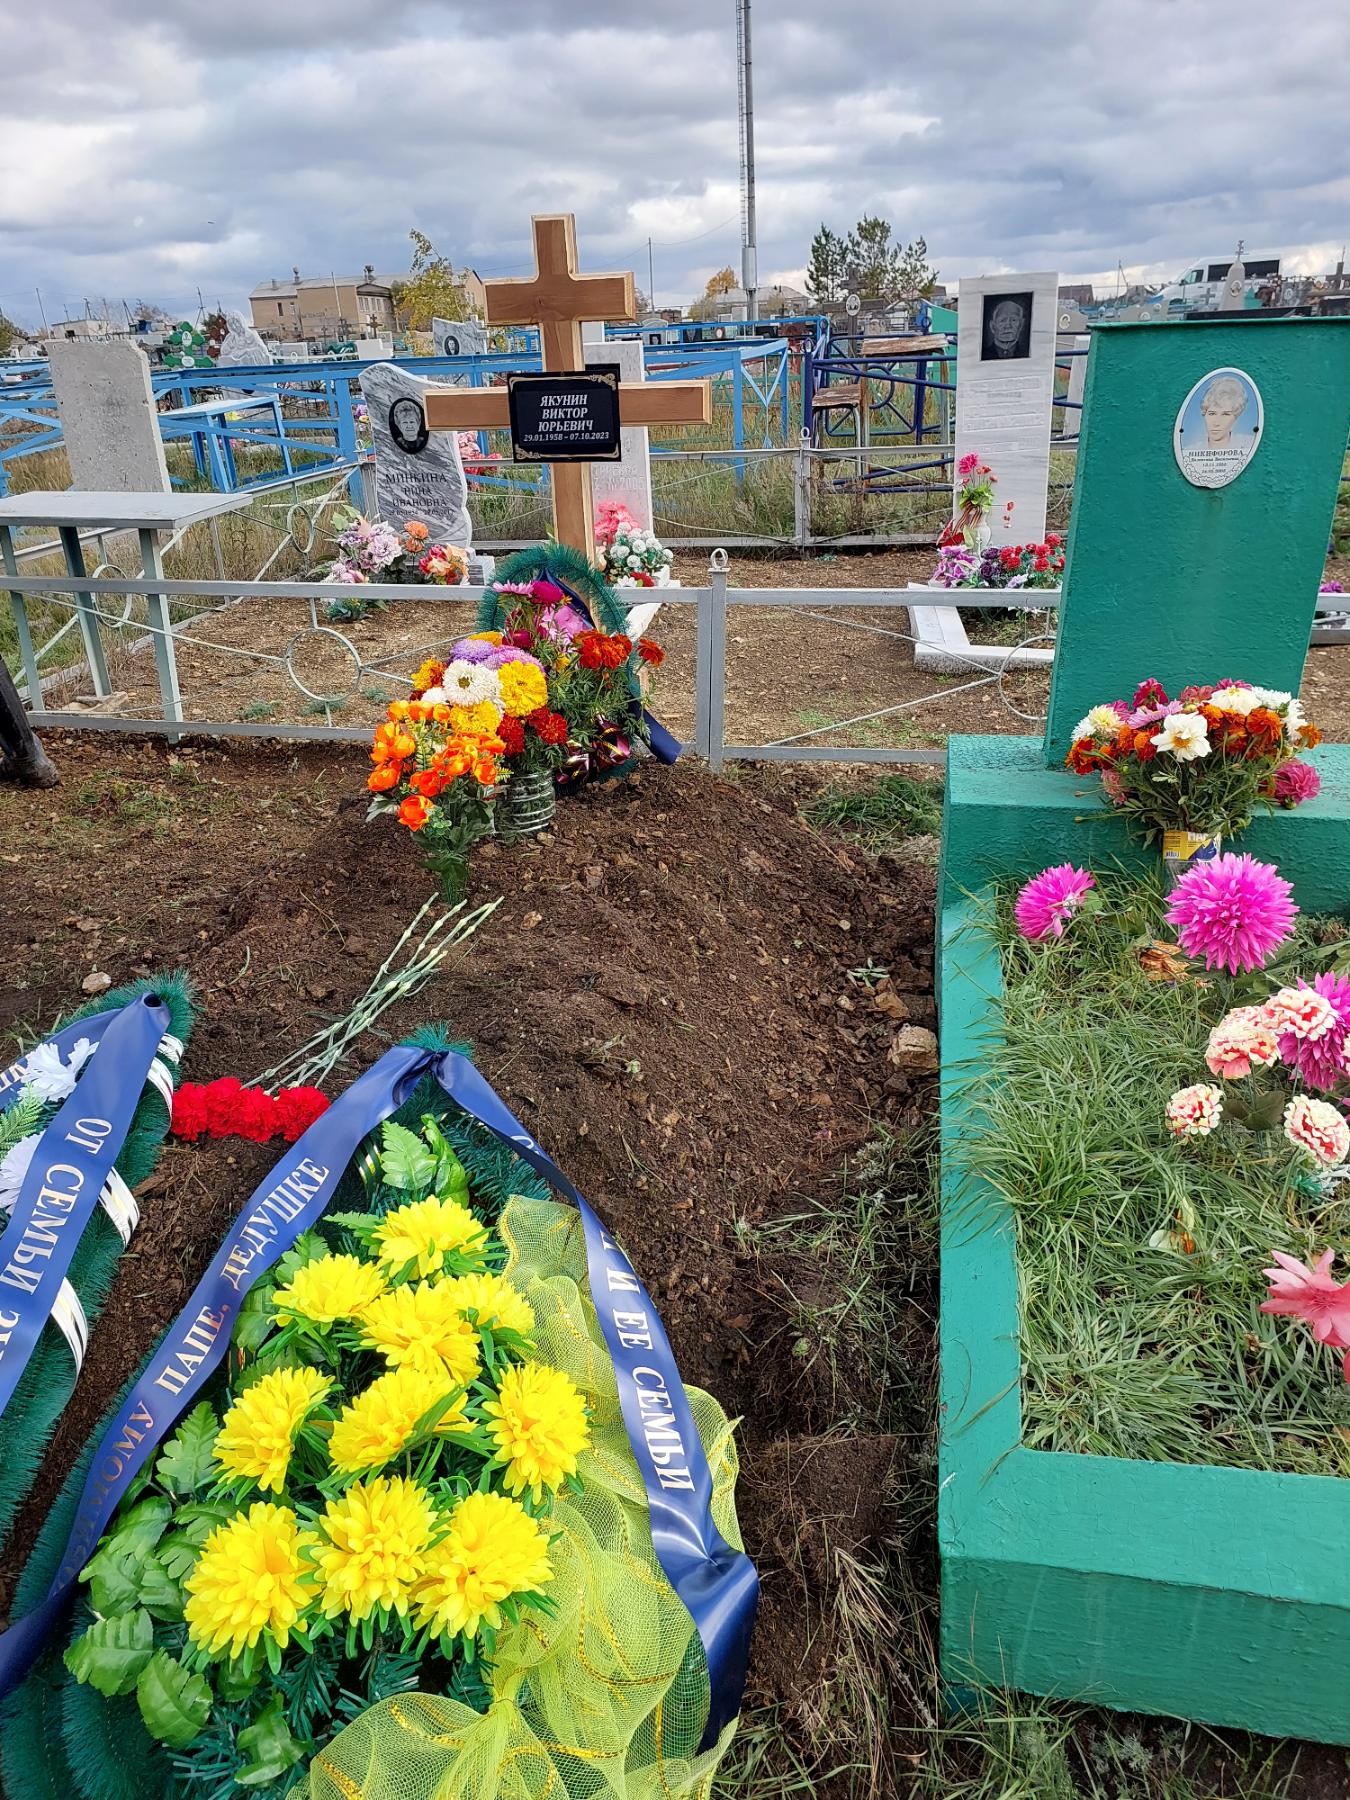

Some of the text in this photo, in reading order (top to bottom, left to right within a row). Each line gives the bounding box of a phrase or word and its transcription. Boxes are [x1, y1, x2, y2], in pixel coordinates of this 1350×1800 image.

[540, 394, 588, 407] ЯКУНИН
[542, 407, 588, 420] ВИКТОР
[523, 433, 563, 442] 29.01.1958
[569, 432, 609, 440] 07.10.2023
[538, 420, 594, 432] ЮРЬЕВИЧ
[386, 473, 447, 483] МИНКИНА
[65, 1117, 113, 1155] ОТ
[0, 1163, 85, 1295] СЕМЬИ
[153, 1305, 231, 1396] ПАПЕ,
[219, 1158, 330, 1291] ДЕДУШКЕ
[606, 1266, 641, 1294] И
[612, 1310, 653, 1353] ЕЕ
[632, 1366, 696, 1493] СЕМЬИ
